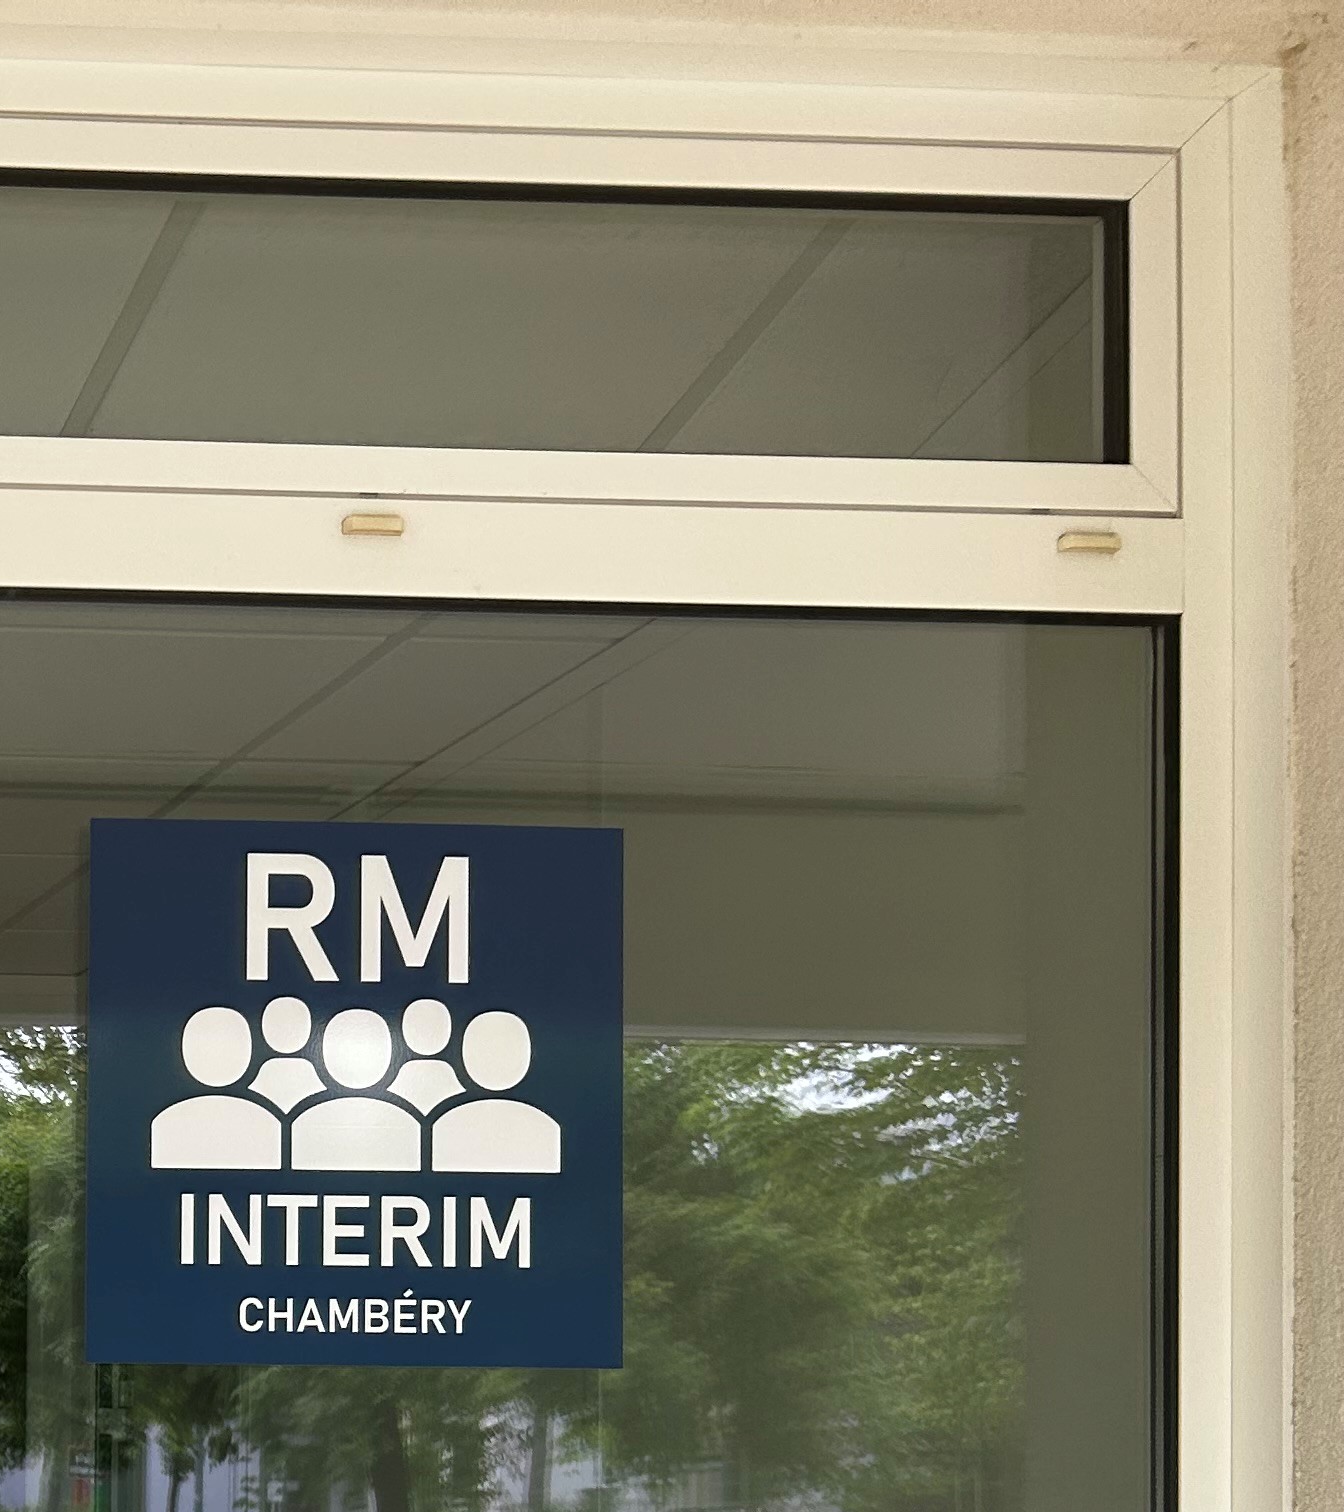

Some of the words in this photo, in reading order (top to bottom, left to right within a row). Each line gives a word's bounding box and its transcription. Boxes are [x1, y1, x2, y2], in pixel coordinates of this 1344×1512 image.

[245, 851, 471, 984] RM
[179, 1192, 532, 1269] INTERIM
[238, 1288, 473, 1335] CHAMBÉRY
